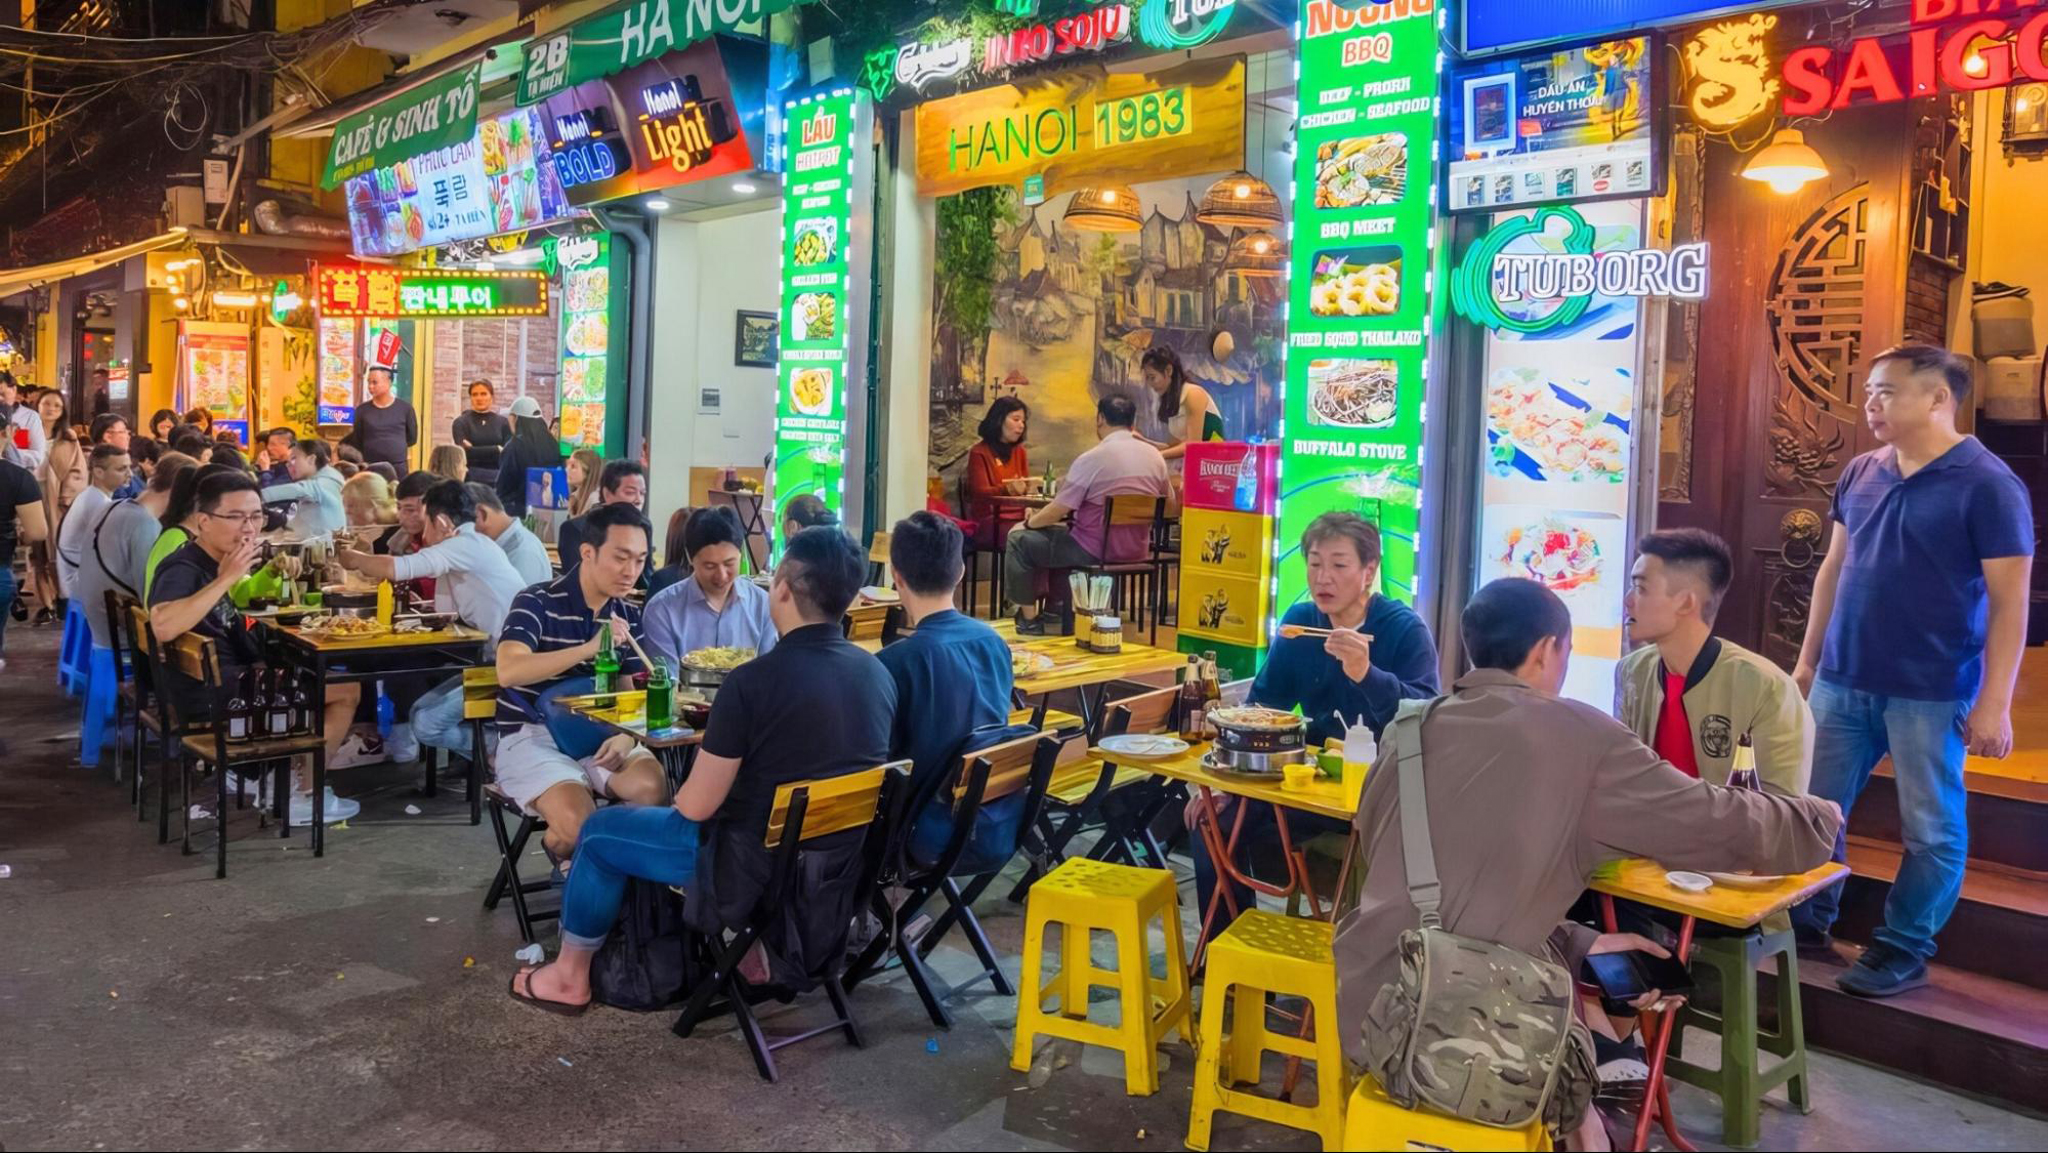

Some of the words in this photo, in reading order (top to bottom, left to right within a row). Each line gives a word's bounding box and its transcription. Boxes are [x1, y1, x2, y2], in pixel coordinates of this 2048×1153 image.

[1055, 5, 1131, 54] SOJU
[1341, 31, 1393, 67] BBQ
[526, 35, 569, 80] 2B
[392, 94, 442, 143] SINH
[641, 107, 713, 172] Light
[949, 105, 1077, 172] HANOI
[1096, 88, 1186, 145] 1983
[553, 142, 616, 188] BOLD
[1321, 221, 1350, 239] BBQ
[1491, 242, 1710, 303] TUBORG
[1293, 440, 1356, 457] BUFFALO
[1358, 442, 1407, 459] STOVE
